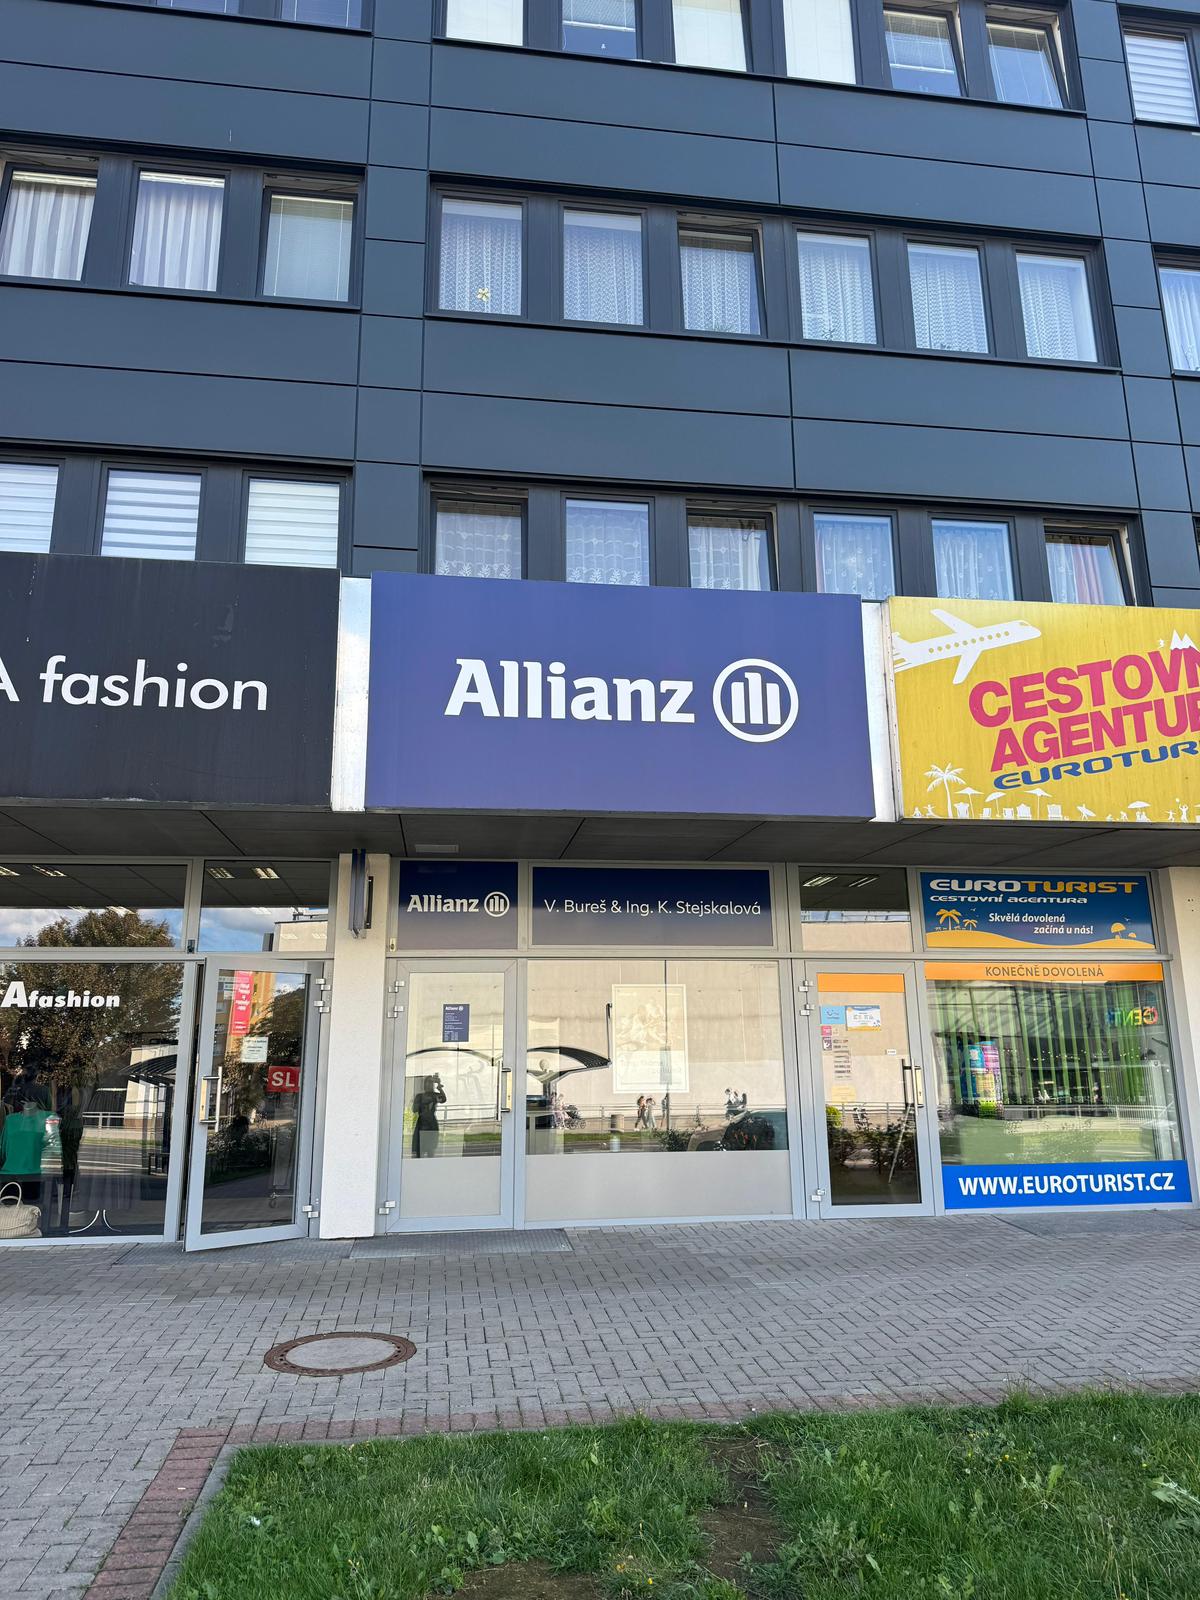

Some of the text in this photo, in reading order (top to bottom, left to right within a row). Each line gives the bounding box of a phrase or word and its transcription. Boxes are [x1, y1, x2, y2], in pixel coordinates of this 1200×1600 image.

[39, 654, 268, 711] fashion
[444, 658, 695, 723] Allianz
[929, 878, 1139, 894] EUROTURIST
[407, 894, 479, 913] Allianz
[544, 899, 761, 917] V. Bureš & Ing. K. Stejskalová
[989, 912, 1066, 923] Skvělá dovolená
[1033, 925, 1065, 934] začíná
[1074, 925, 1094, 934] nás!
[1042, 965, 1104, 977] DOVOLENÁ
[958, 1173, 1176, 1196] WWW.EUROTURIST.CZ
